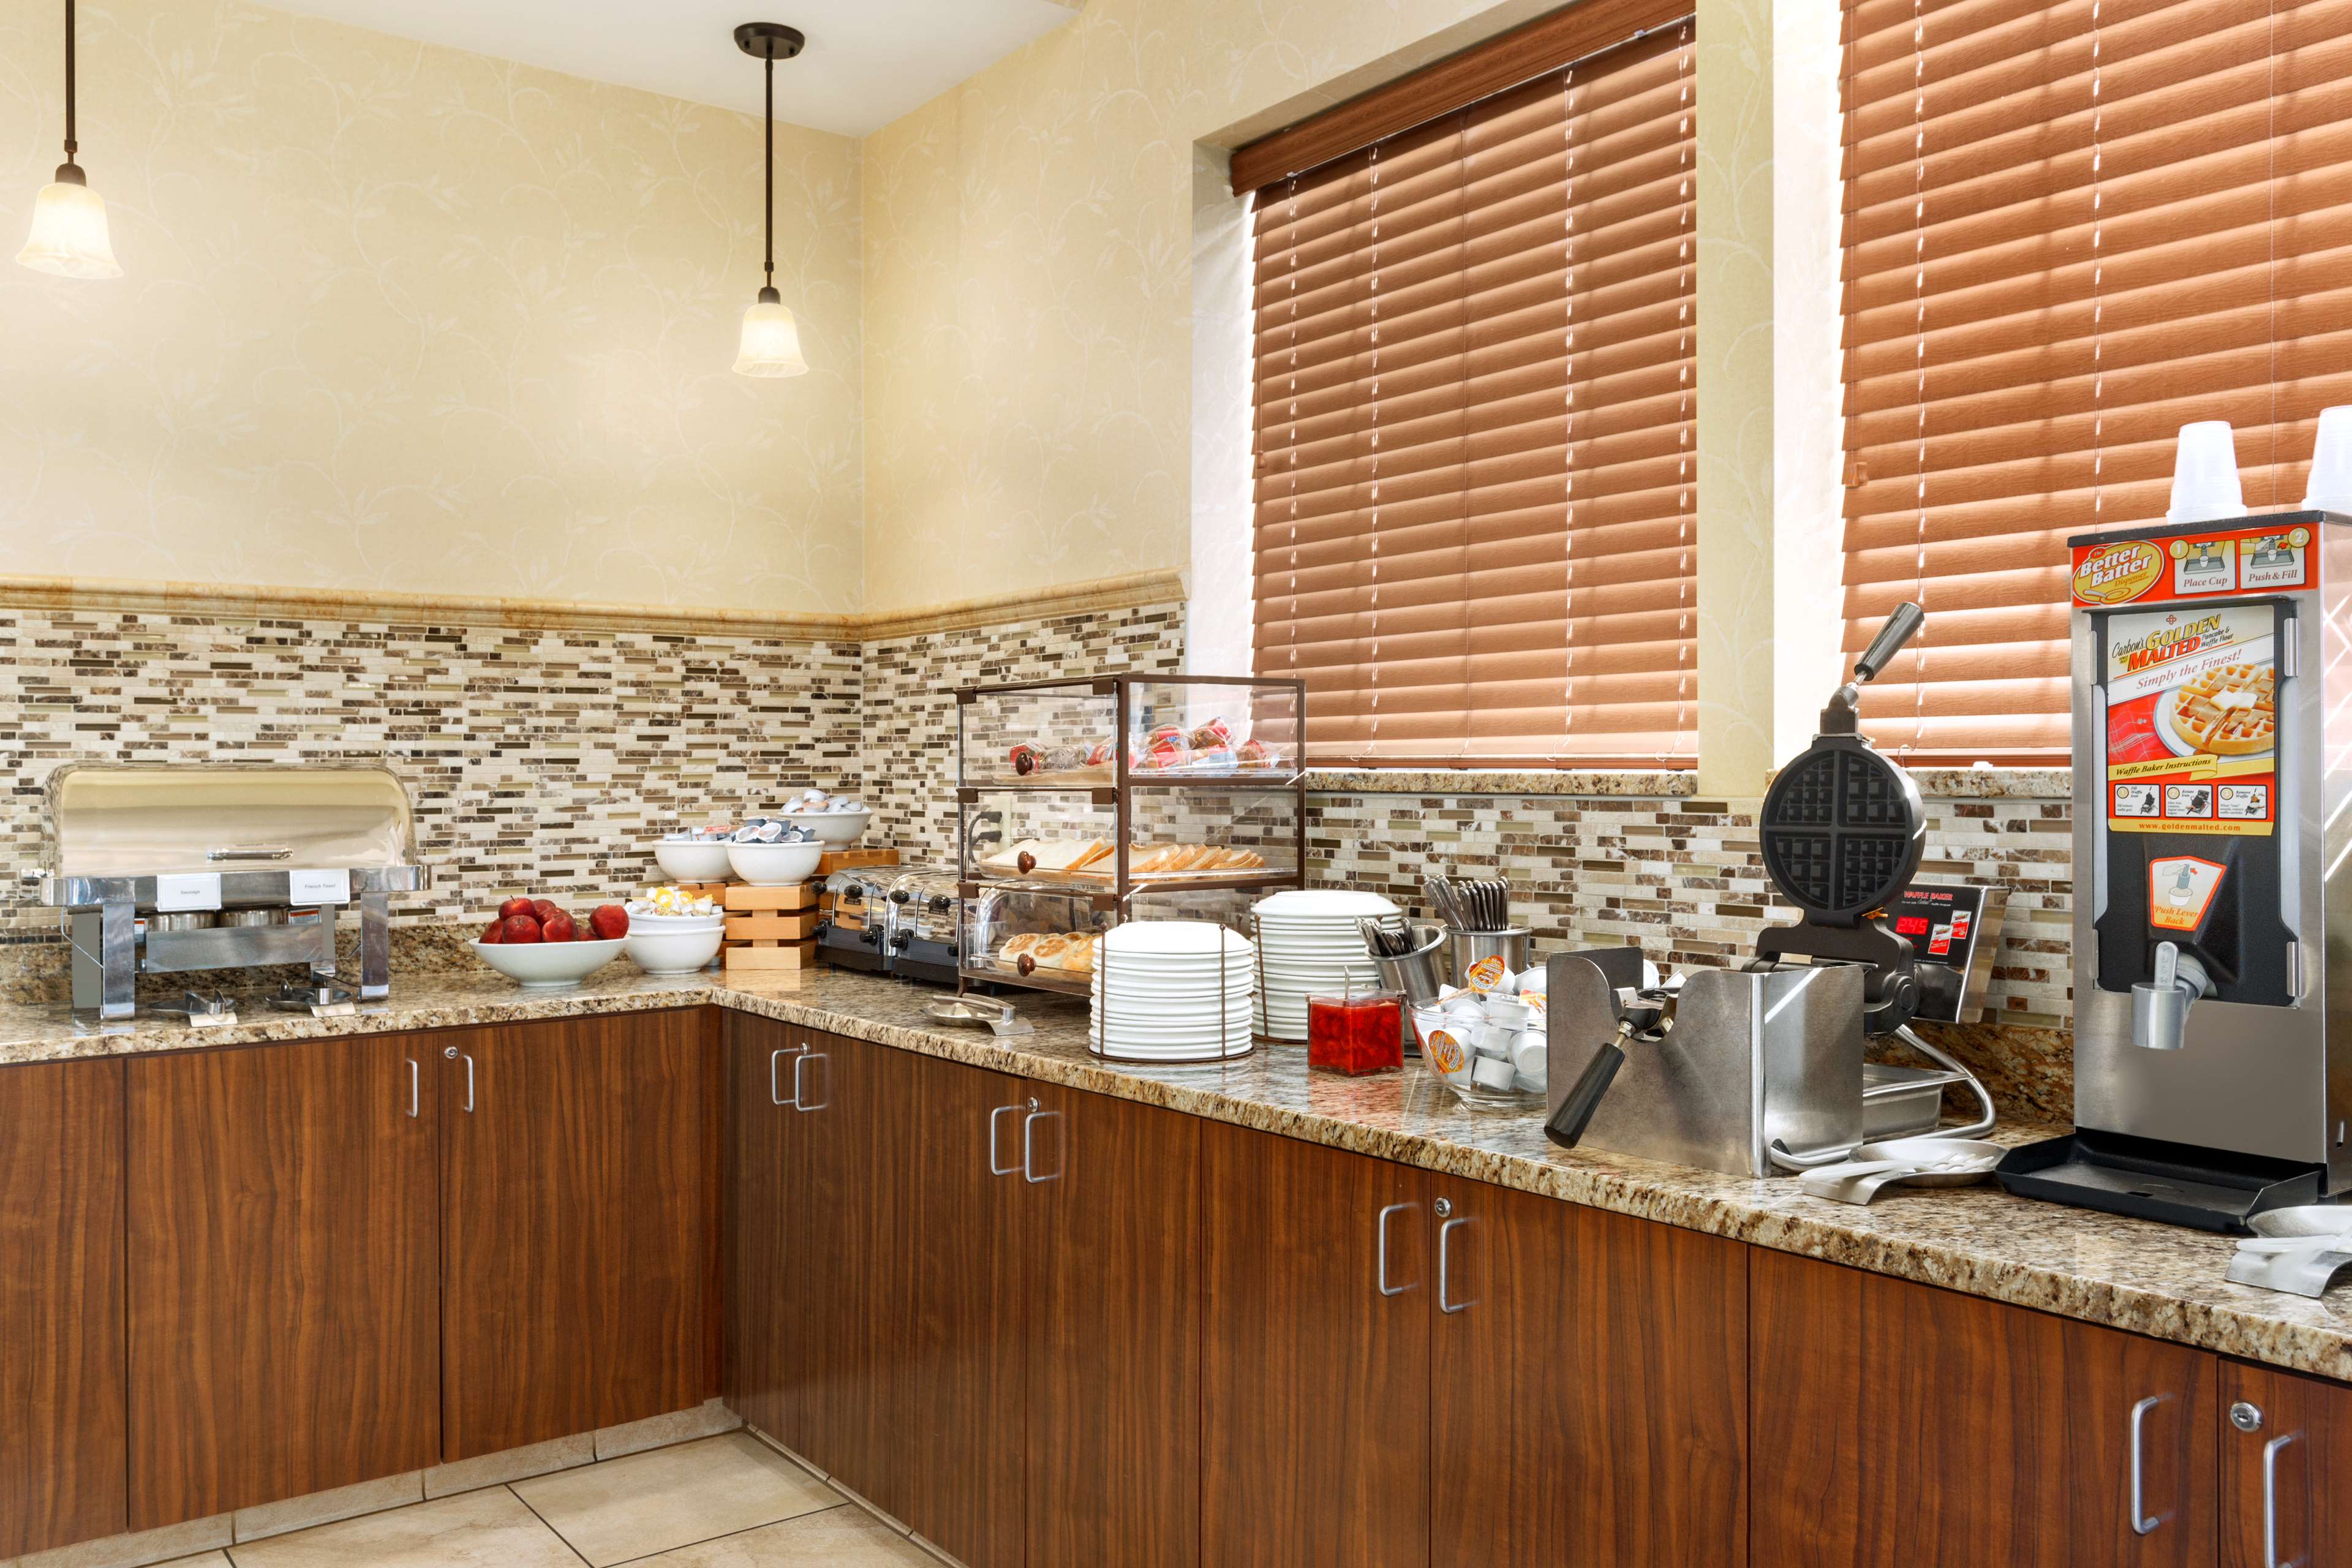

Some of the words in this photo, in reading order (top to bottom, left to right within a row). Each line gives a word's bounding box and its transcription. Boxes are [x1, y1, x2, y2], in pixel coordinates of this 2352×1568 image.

[2294, 532, 2304, 543] 2
[2176, 544, 2182, 555] 1
[2079, 545, 2141, 578] Better
[2091, 554, 2152, 588] Batter
[2248, 571, 2271, 582] Push
[2282, 570, 2297, 579] Fill
[2115, 572, 2147, 586] Dispenser
[2184, 578, 2207, 587] Place
[2209, 576, 2228, 586] Cup
[2145, 613, 2221, 650] GOLDEN
[2202, 629, 2224, 640] Pancake
[2201, 638, 2218, 647] Waffle
[2220, 633, 2234, 643] Flour
[2127, 636, 2201, 672] MALTED
[2136, 670, 2177, 690] Simply
[2180, 665, 2198, 677] the
[2200, 649, 2242, 671] Finest!
[2116, 766, 2140, 776] Waffle
[2165, 758, 2211, 770] Instructions
[1930, 892, 1953, 901] BAKER
[2155, 906, 2174, 914] Push
[2176, 908, 2199, 917] Lever
[2165, 916, 2185, 925] Back
